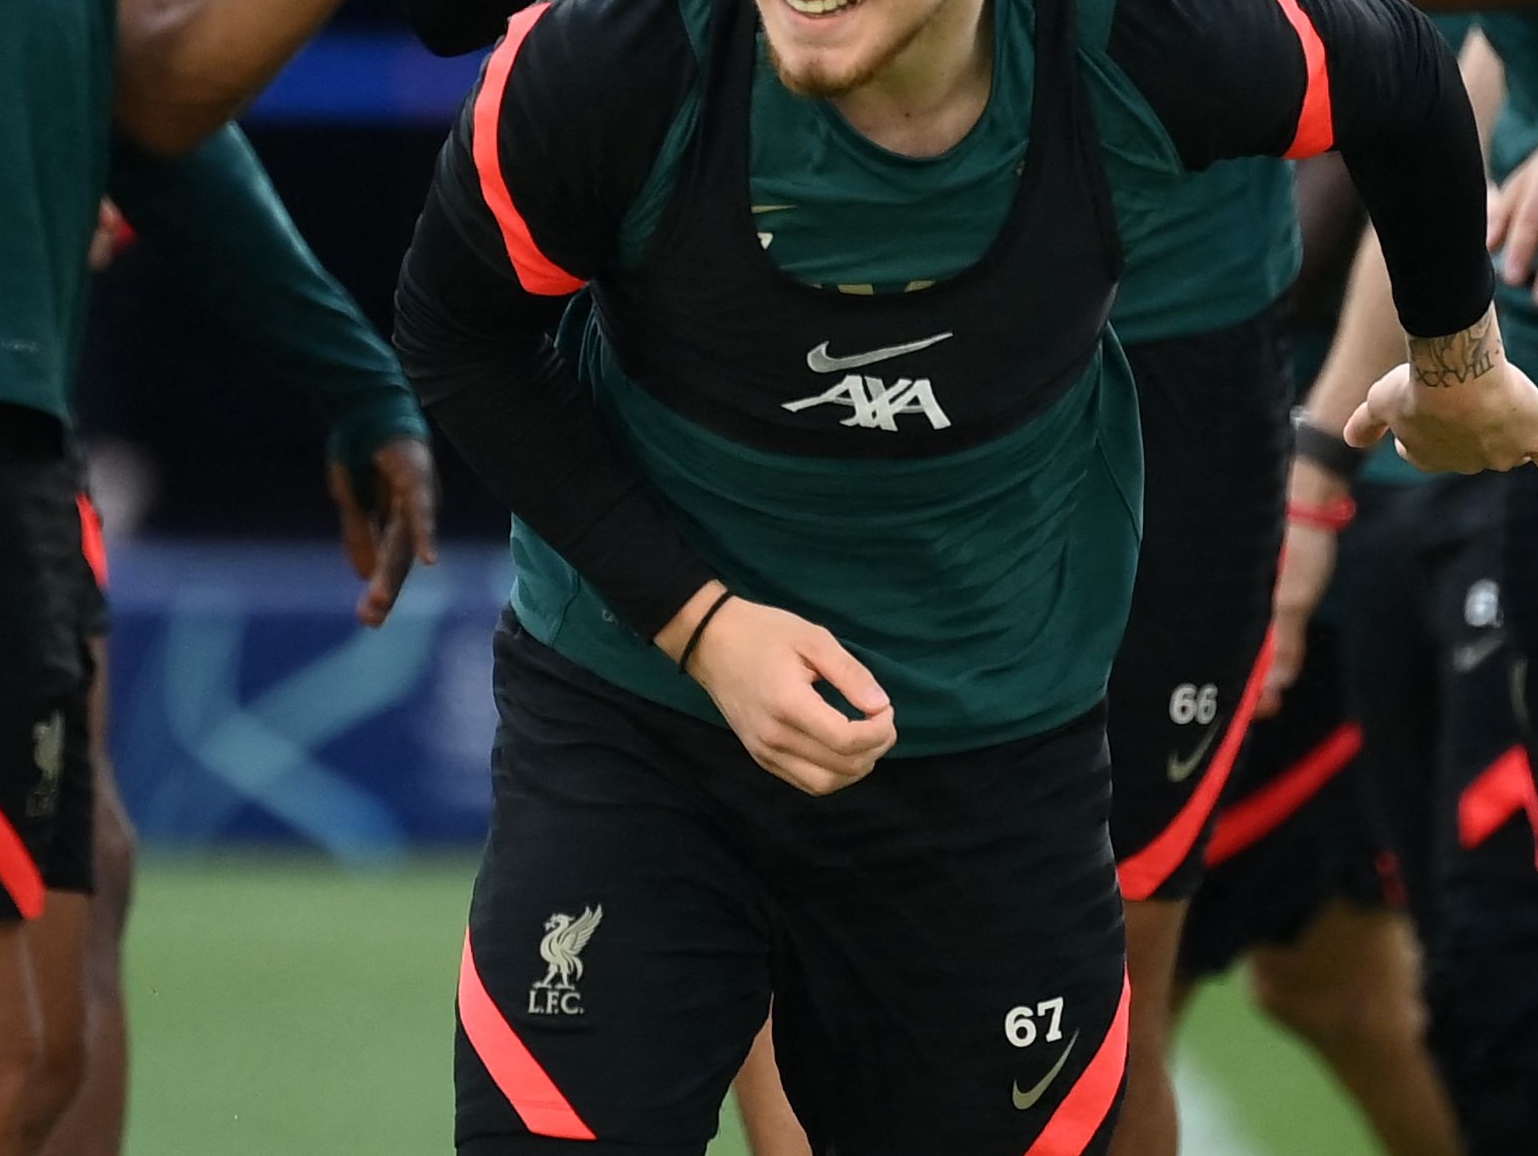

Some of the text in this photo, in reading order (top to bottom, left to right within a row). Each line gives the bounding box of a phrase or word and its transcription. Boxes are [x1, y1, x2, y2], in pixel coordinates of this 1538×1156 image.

[780, 374, 952, 432] AXA
[1169, 683, 1218, 725] 66
[527, 990, 585, 1015] L.F.C.
[1005, 996, 1064, 1048] 67
